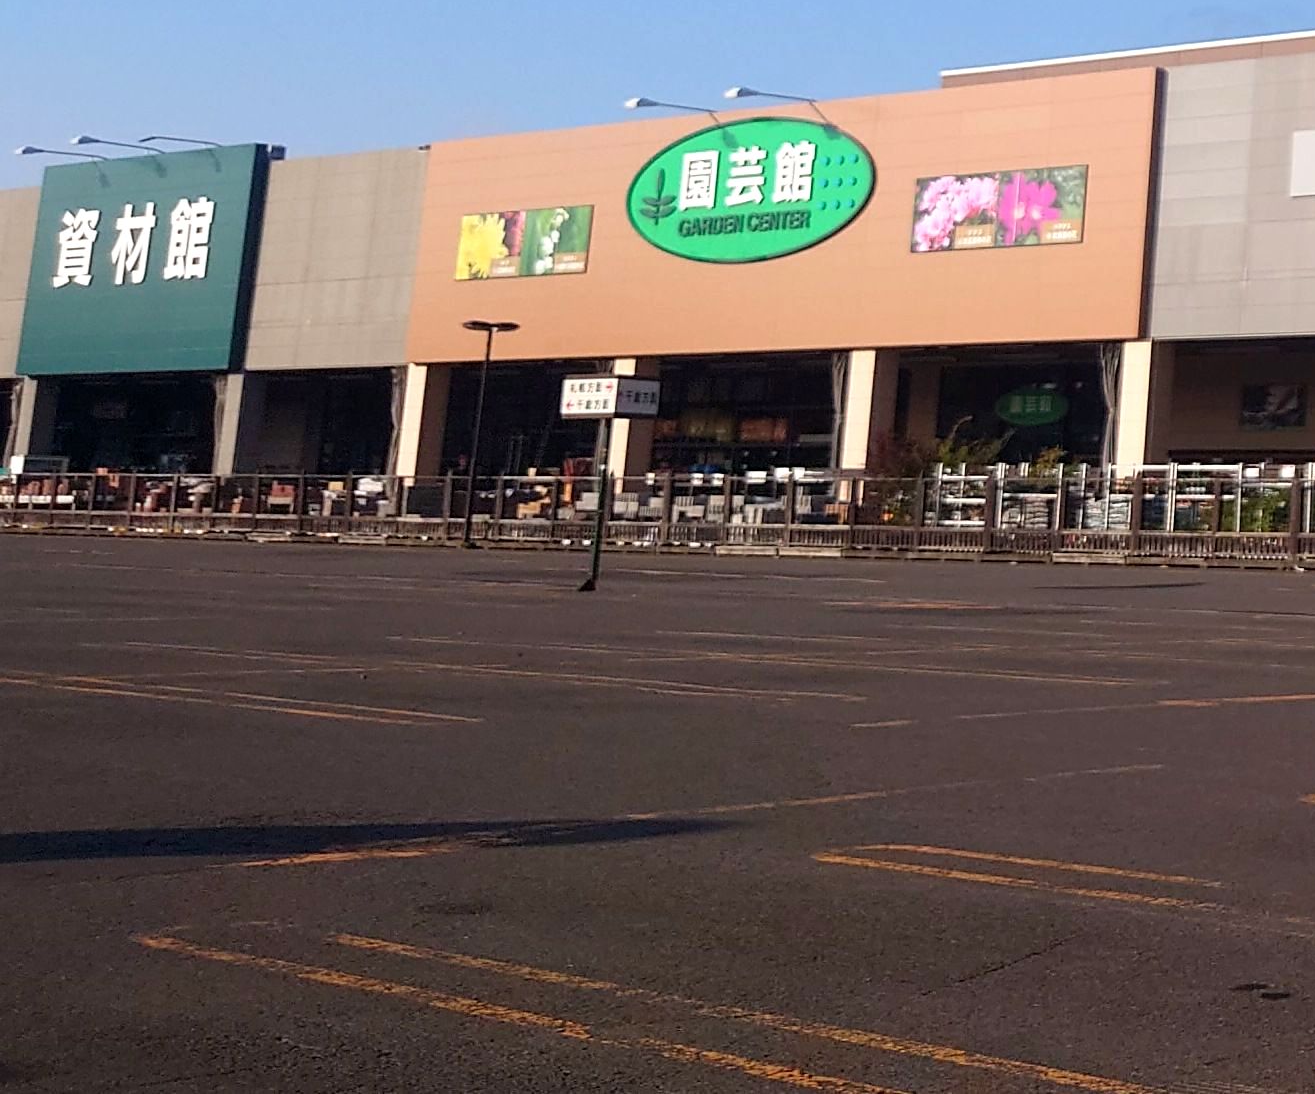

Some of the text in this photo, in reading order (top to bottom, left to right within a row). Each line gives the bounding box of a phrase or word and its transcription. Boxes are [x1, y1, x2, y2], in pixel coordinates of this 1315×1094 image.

[678, 140, 817, 211] 園芸館
[53, 196, 215, 288] 資材館
[678, 210, 811, 237] GARDEN CENTER
